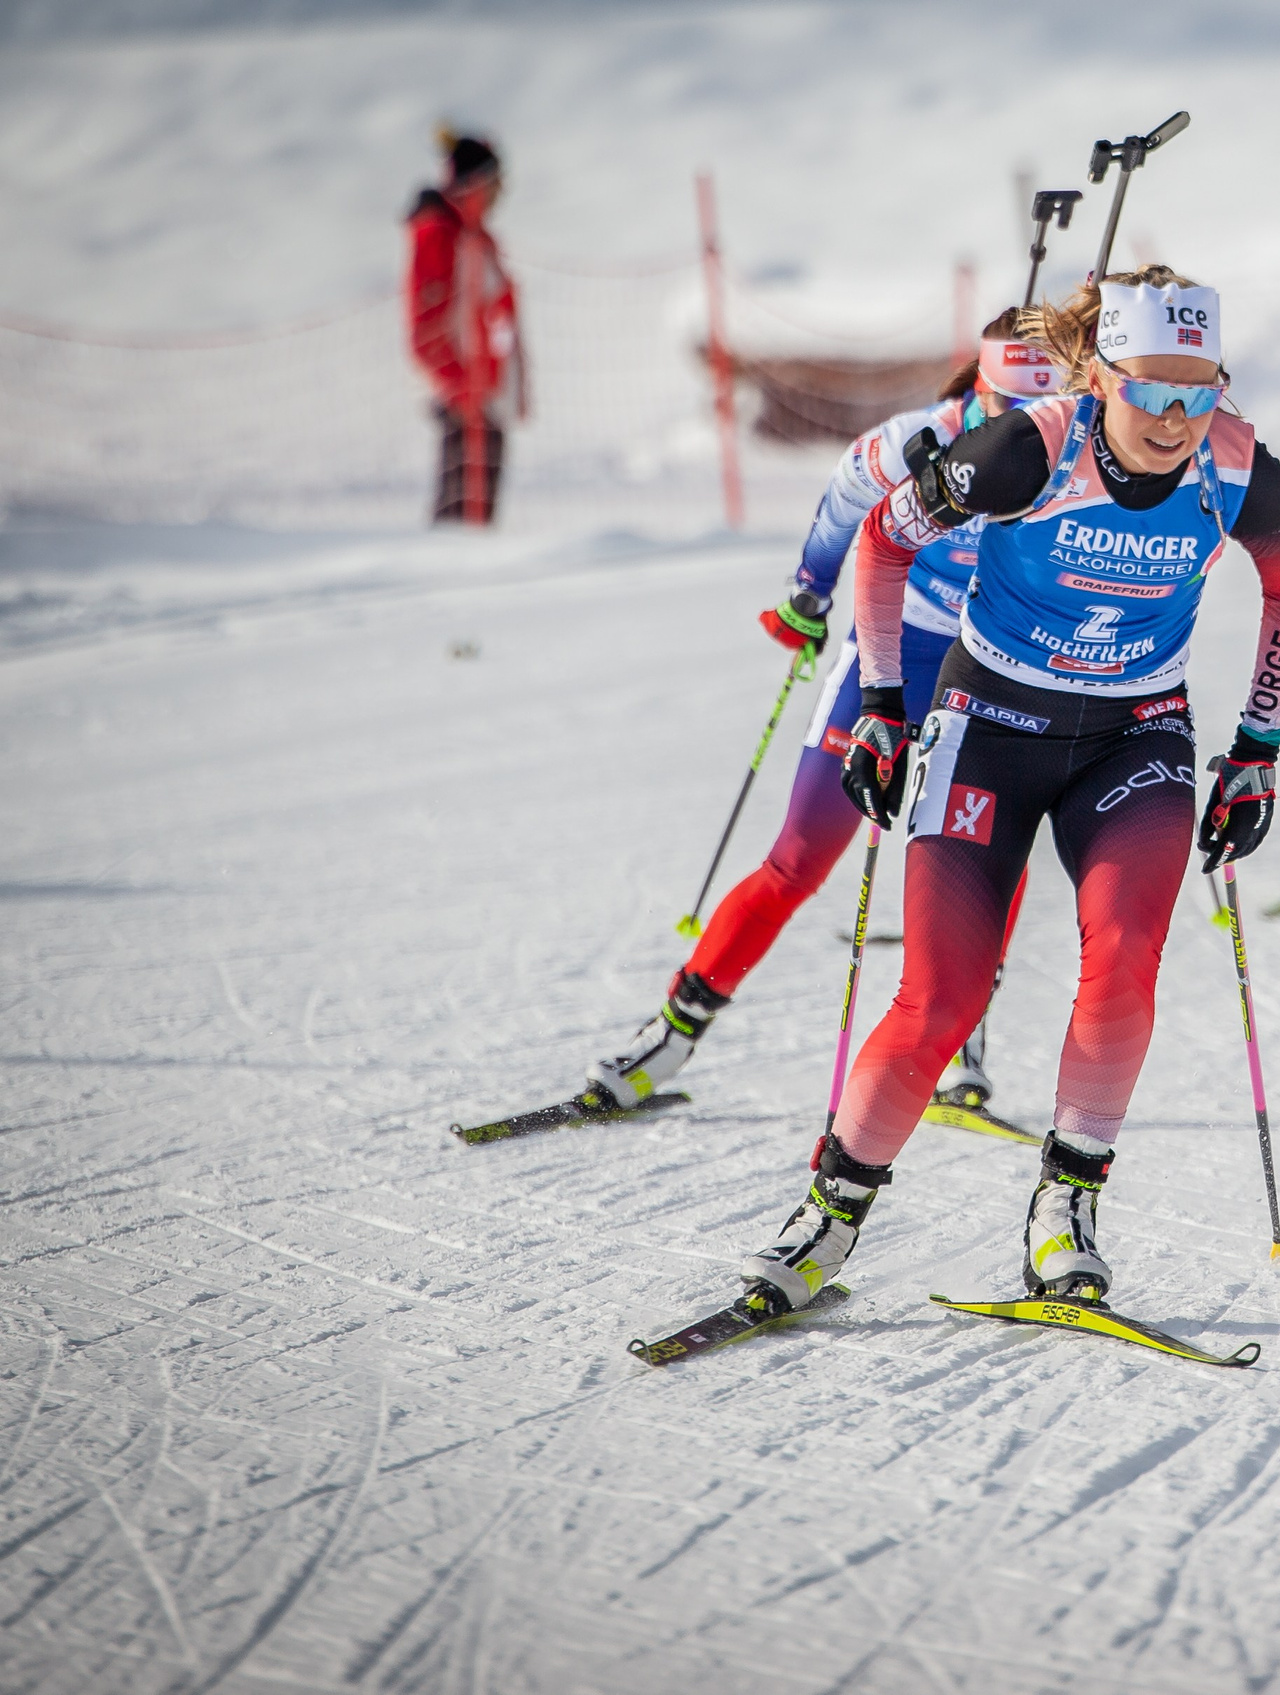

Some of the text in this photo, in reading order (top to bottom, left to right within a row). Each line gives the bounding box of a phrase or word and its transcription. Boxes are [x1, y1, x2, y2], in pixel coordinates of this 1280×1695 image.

[1165, 306, 1208, 329] ice
[1100, 334, 1128, 350] dlo
[1054, 518, 1198, 560] ERDINGER
[1049, 549, 1194, 577] ALKOHOLFREI
[1072, 579, 1164, 597] GRAPEFRUIT
[1073, 605, 1125, 643] 2
[1029, 626, 1156, 662] HOCHFILZEN
[971, 704, 1039, 731] LAPUA
[1095, 760, 1197, 813] odlo
[1225, 779, 1242, 800] LEKI
[1254, 800, 1268, 830] KINET
[810, 1184, 853, 1222] ISCHER
[1040, 1304, 1081, 1325] FISCHER
